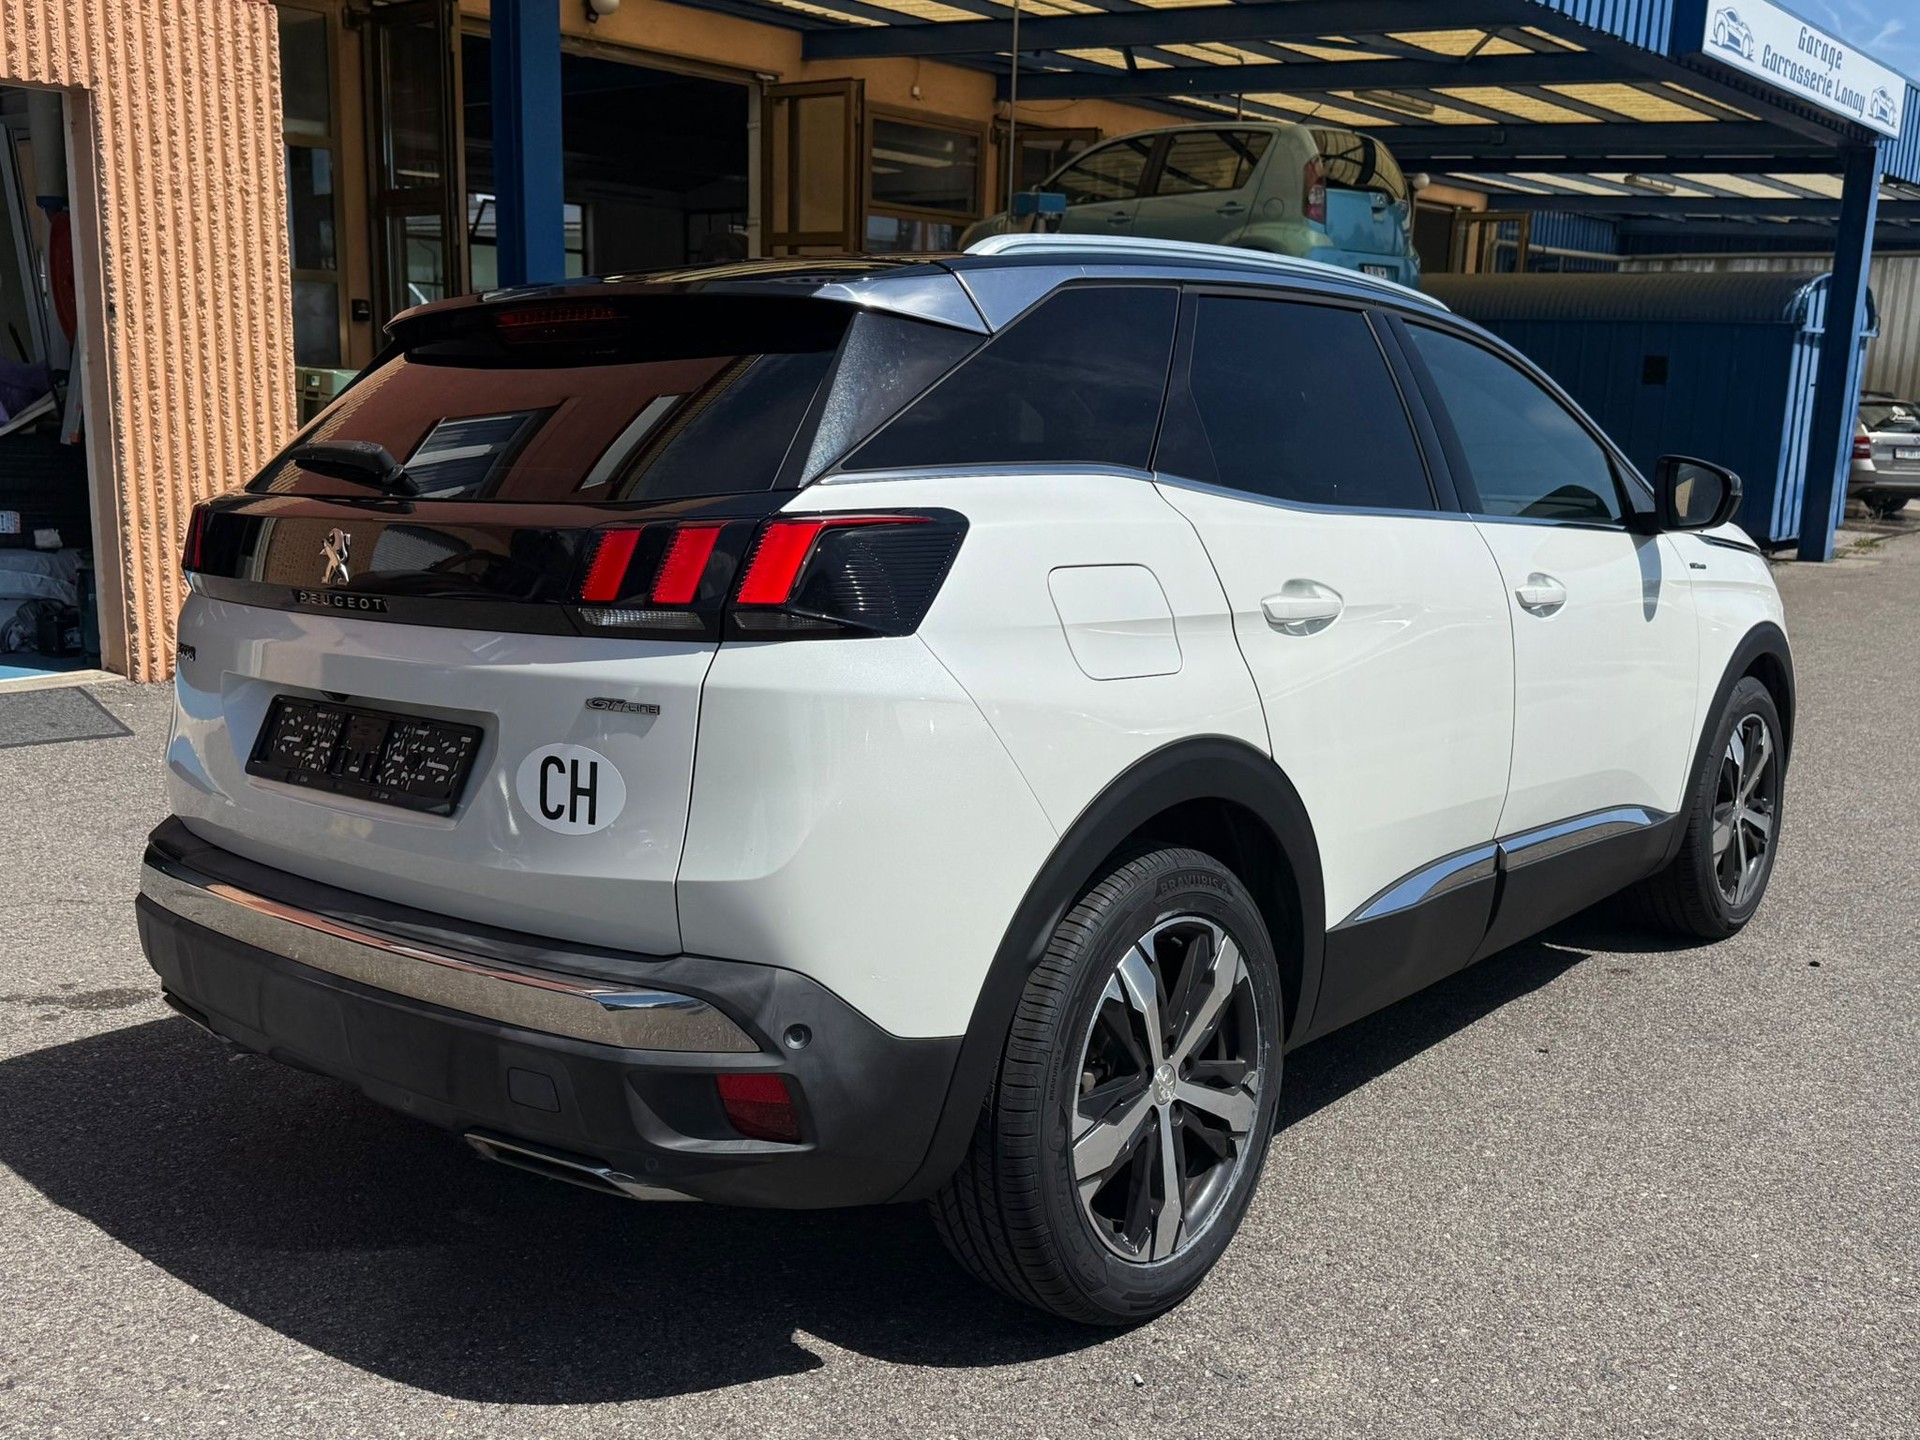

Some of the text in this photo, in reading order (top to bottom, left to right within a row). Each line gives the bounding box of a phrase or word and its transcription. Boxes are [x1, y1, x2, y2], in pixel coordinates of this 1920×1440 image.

[1798, 26, 1843, 71] Garage
[1761, 44, 1833, 98] Carrosserie
[299, 591, 383, 611] PEUGEOT
[585, 697, 627, 712] GT
[539, 754, 598, 826] CH
[1160, 874, 1219, 896] BRAVURIS
